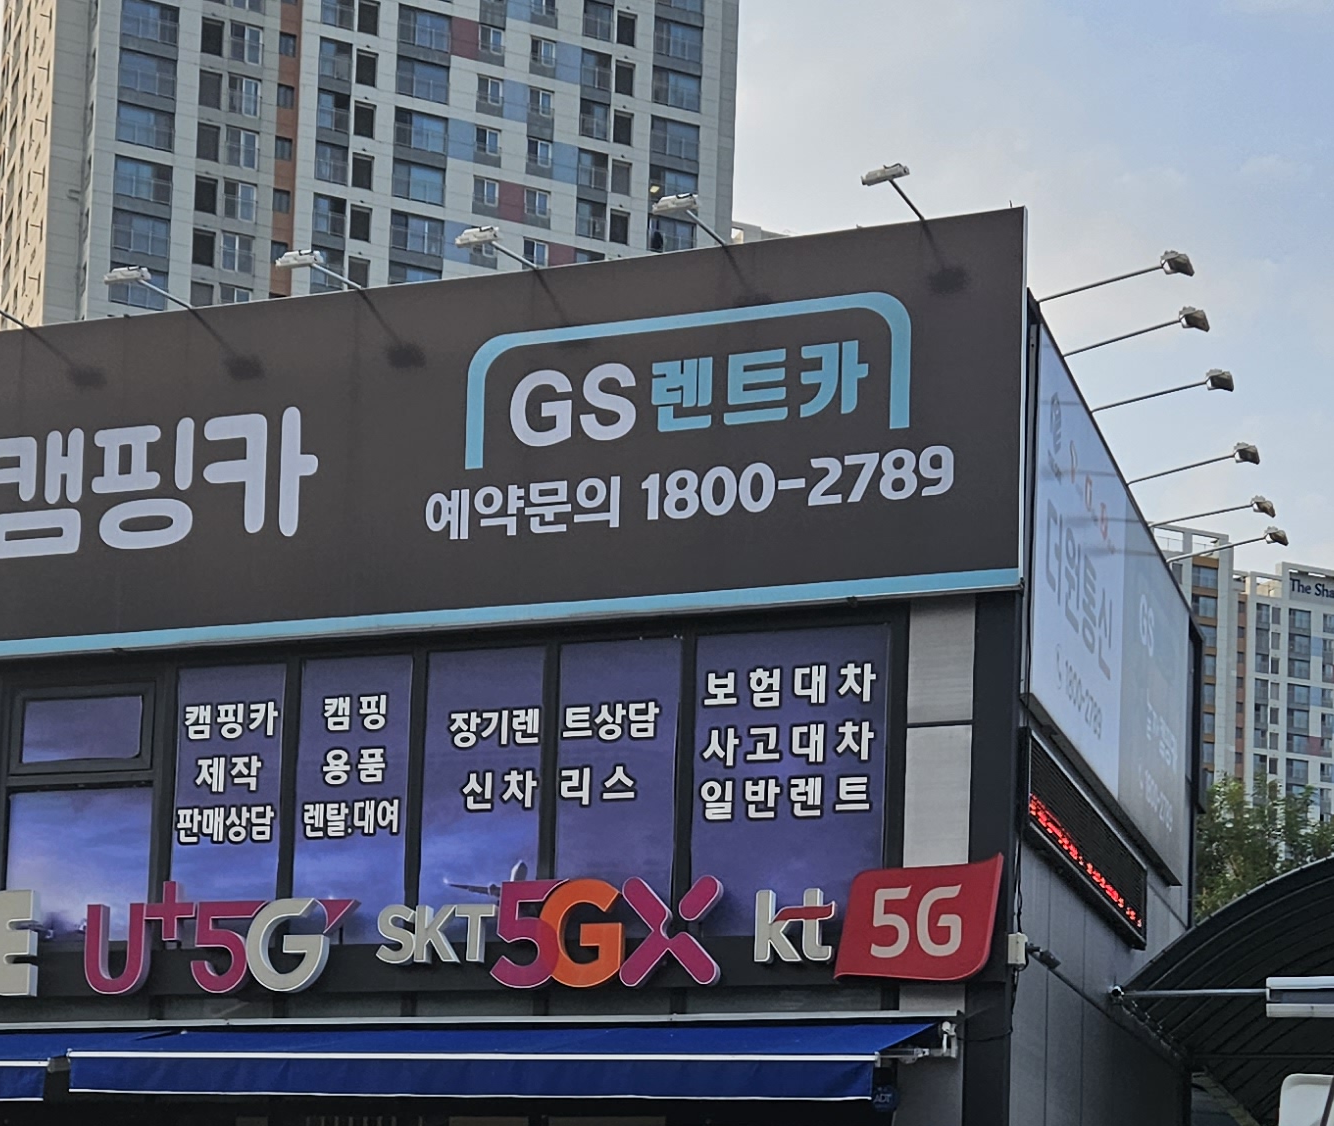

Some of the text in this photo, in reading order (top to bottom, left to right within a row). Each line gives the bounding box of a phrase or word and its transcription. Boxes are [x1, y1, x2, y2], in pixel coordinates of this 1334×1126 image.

[425, 445, 954, 539] 예약문의 1800-2789
[1289, 577, 1312, 594] The
[1139, 594, 1155, 657] GS
[703, 663, 876, 708] 보험대차
[185, 701, 278, 739] 캠핑카
[323, 694, 387, 731] 캠핑
[702, 721, 874, 766] 사고대차
[195, 755, 262, 792] 제작
[322, 747, 386, 785] 용품
[700, 776, 870, 821] 일반렌트
[176, 805, 275, 843] 판매상담
[753, 883, 964, 963] kt 5G
